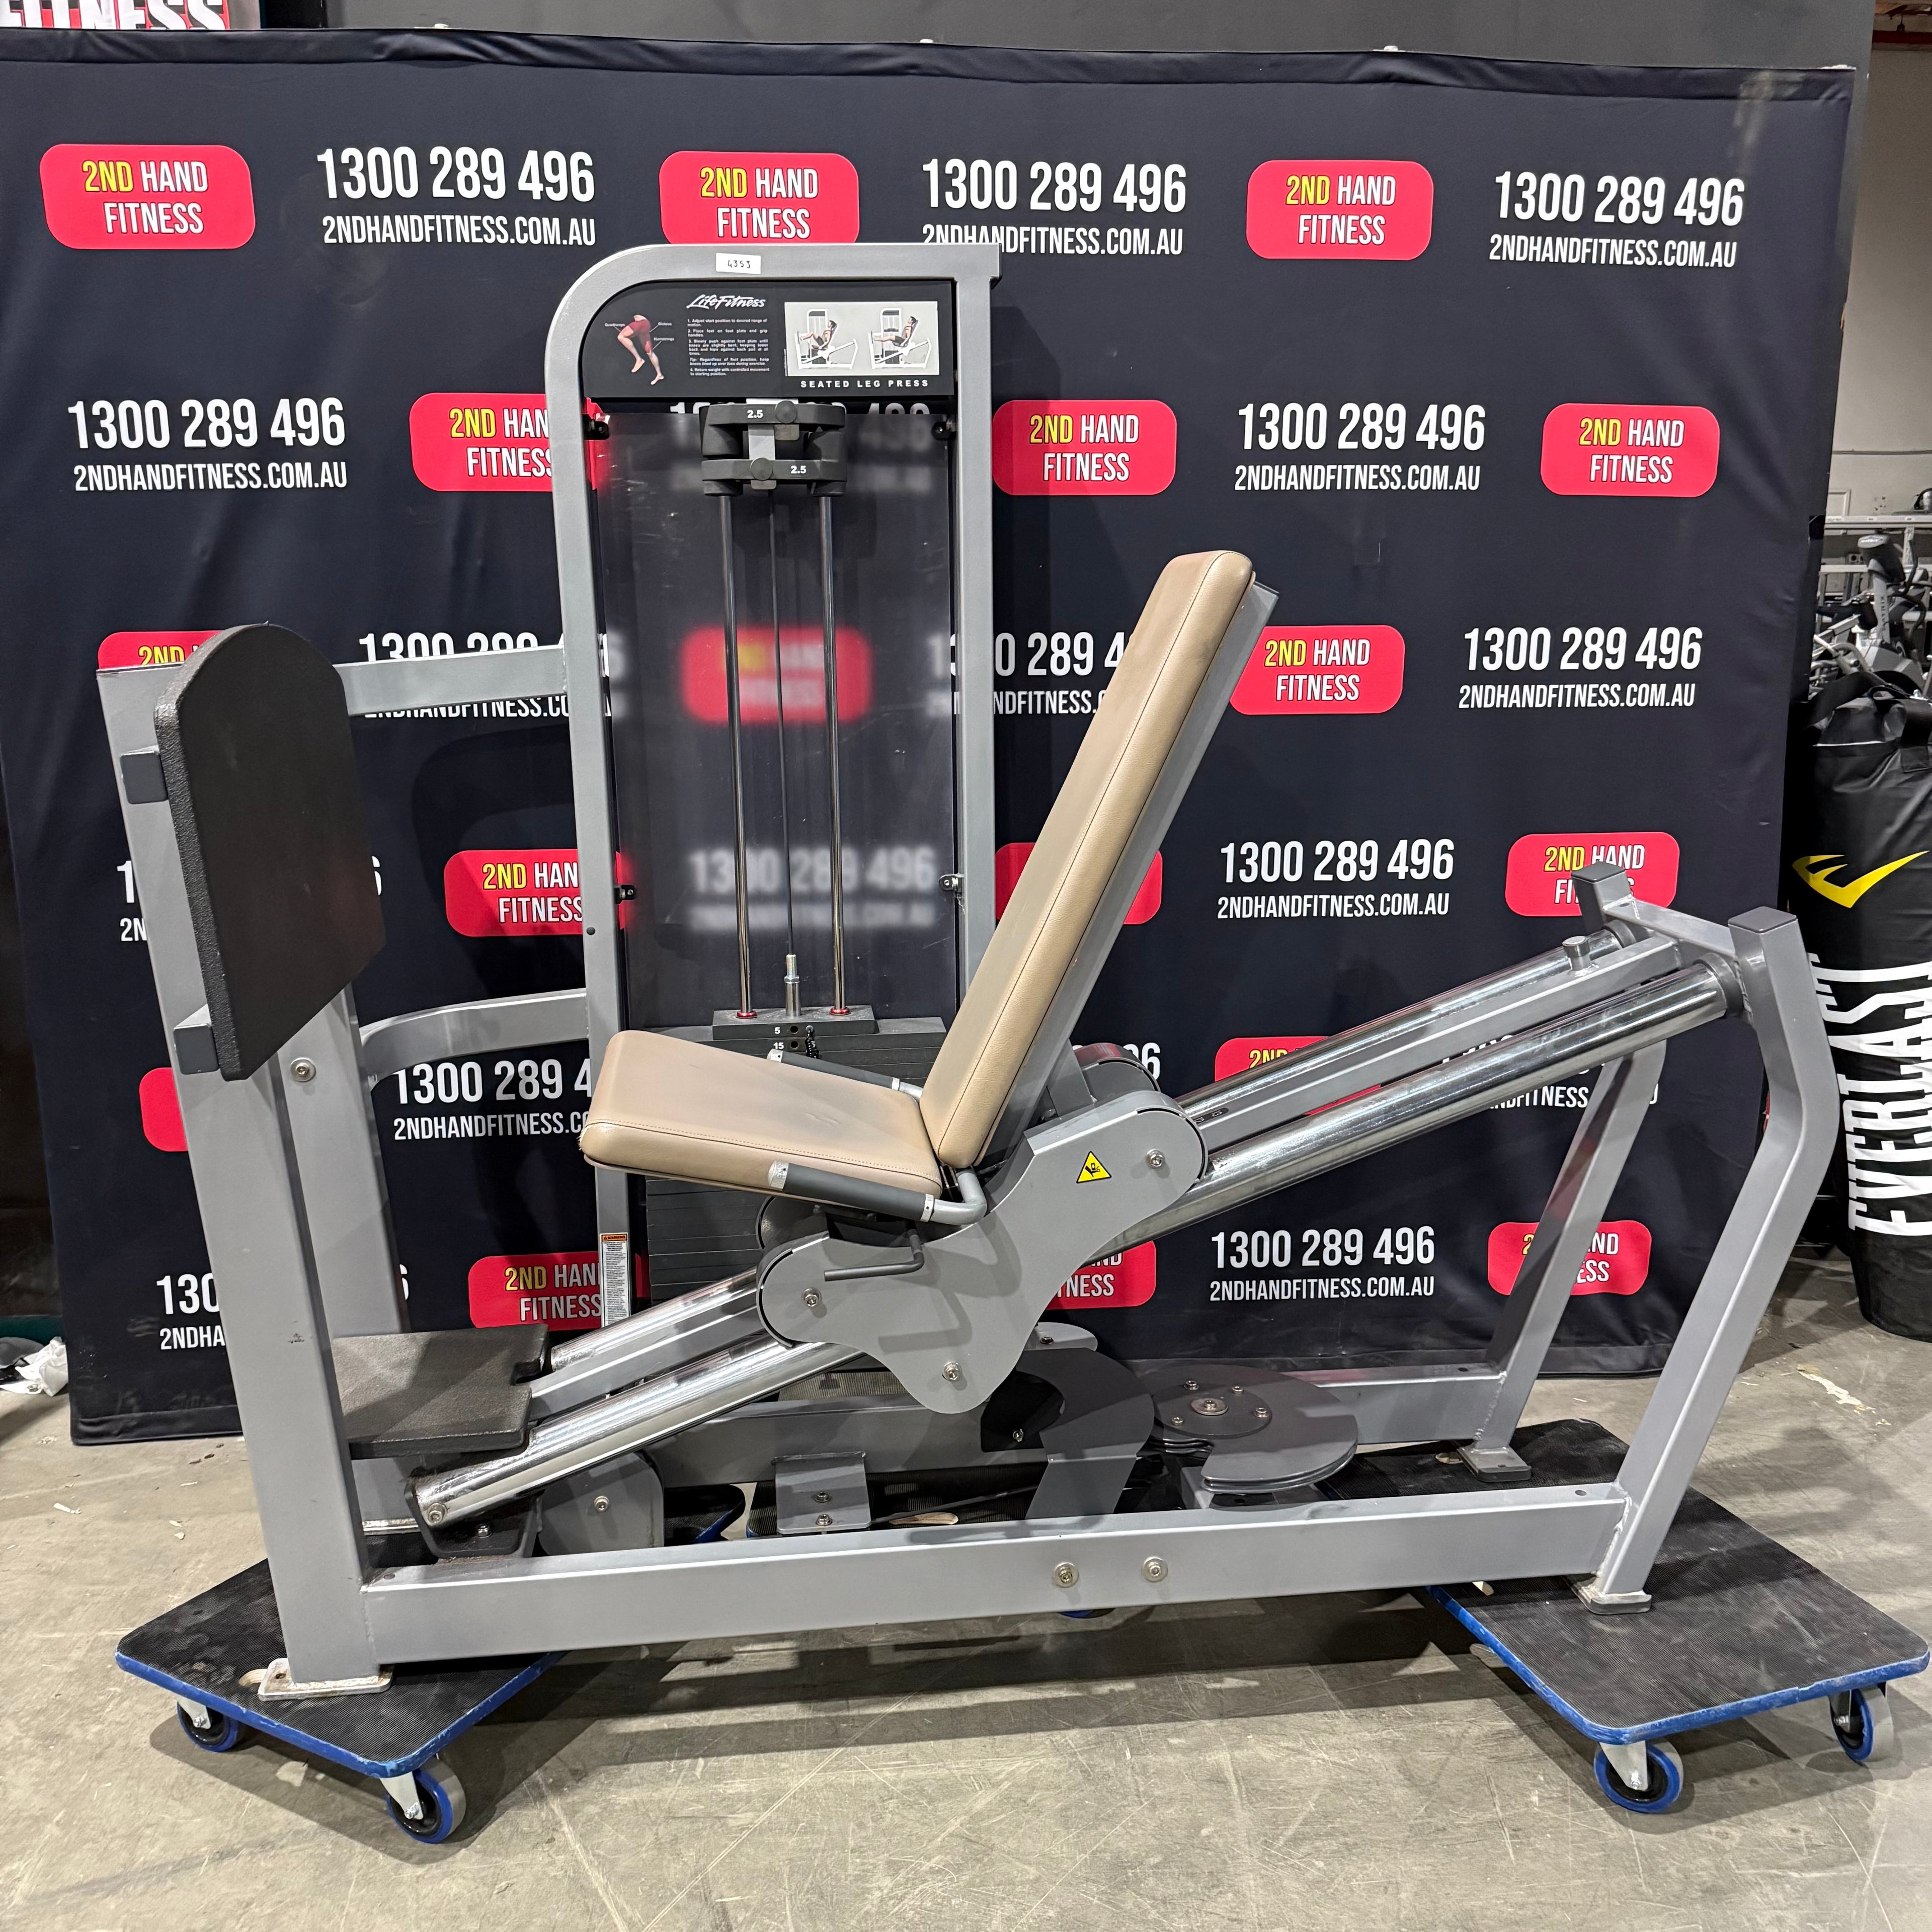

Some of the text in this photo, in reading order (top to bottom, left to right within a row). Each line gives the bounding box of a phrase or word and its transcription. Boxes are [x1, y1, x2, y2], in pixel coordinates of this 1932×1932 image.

[83, 161, 207, 191] 2ND HAND
[317, 146, 594, 202] 1300 289 496
[701, 168, 818, 198] 2ND HAND
[923, 159, 1186, 212] 1300 289 496
[1286, 176, 1395, 205] 2ND HAND
[1496, 171, 1744, 225] 1300 289 496
[105, 203, 203, 233] FITNESS
[323, 215, 595, 246] 2NDHANDFITNESS.COM.AU
[718, 208, 810, 238] FITNESS
[1299, 215, 1385, 244] FITNESS
[728, 260, 751, 268] 4353
[1490, 234, 1737, 267] 2NDHANDFITNESS.COM.AU
[68, 397, 345, 448] 1300 289 496
[450, 409, 546, 437] 2ND HAN
[747, 410, 763, 418] 2.5
[1239, 403, 1485, 450] 1300 289 496
[1031, 415, 1138, 443] 2ND HAND
[1580, 418, 1684, 446] 2ND HAND
[74, 462, 347, 491] 2NDHANDFITNESS.COM.AU
[791, 465, 806, 473] 2.5
[1044, 453, 1129, 480] FITNESS
[1235, 465, 1480, 490] 2NDHANDFITNESS.COM.AU
[1591, 455, 1672, 482] FITNESS
[1028, 632, 1093, 676] 289
[1265, 639, 1370, 666] 2ND HAND
[1465, 627, 1702, 670] 1300 289 496
[1277, 675, 1359, 700] FITNESS
[1459, 684, 1695, 708] 2NDHANDFITNESS.COM.AU
[1221, 839, 1454, 882] 1300 289 496
[1545, 847, 1584, 871] 2ND
[483, 862, 578, 889] 2ND HAN
[1218, 893, 1449, 918] 2NDHANDFITNESS.COM.AU
[773, 1041, 784, 1050] 15
[390, 1059, 484, 1105] 1300
[495, 1059, 562, 1100] 289
[393, 1111, 589, 1140] 2NDHANDFITNESS.C
[1212, 1226, 1434, 1268] 1300 289 496
[505, 1265, 547, 1291] 2ND
[1058, 1273, 1114, 1298] NESS
[1211, 1276, 1434, 1301] 2NDHANDFITNESS.COM.AU
[156, 1273, 219, 1315] 130
